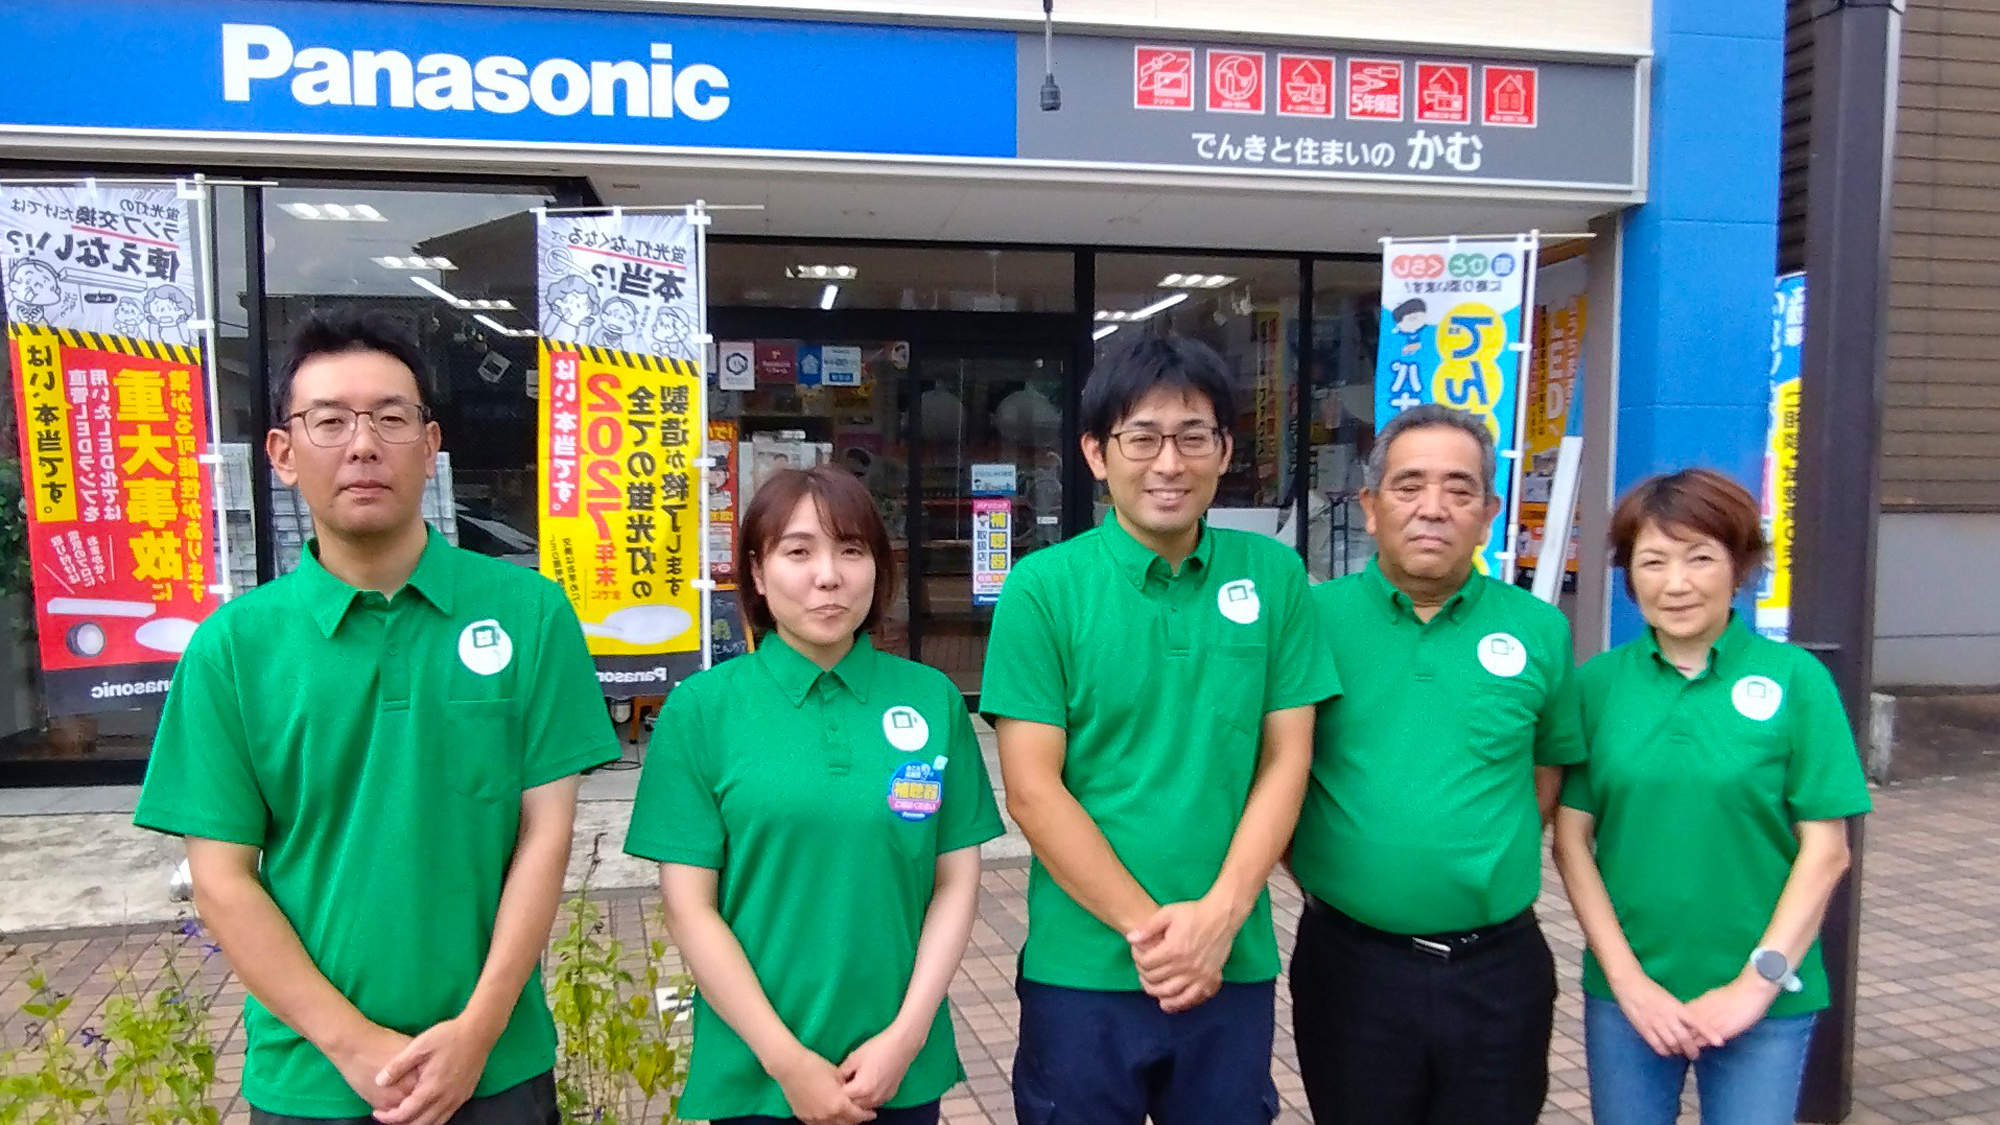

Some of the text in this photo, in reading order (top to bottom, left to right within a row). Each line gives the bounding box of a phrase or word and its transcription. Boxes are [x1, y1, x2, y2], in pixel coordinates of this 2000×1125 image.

[222, 23, 730, 121] Panasonic
[1349, 93, 1399, 115] 5年保証
[1192, 129, 1484, 173] でんきと住まいの かむ
